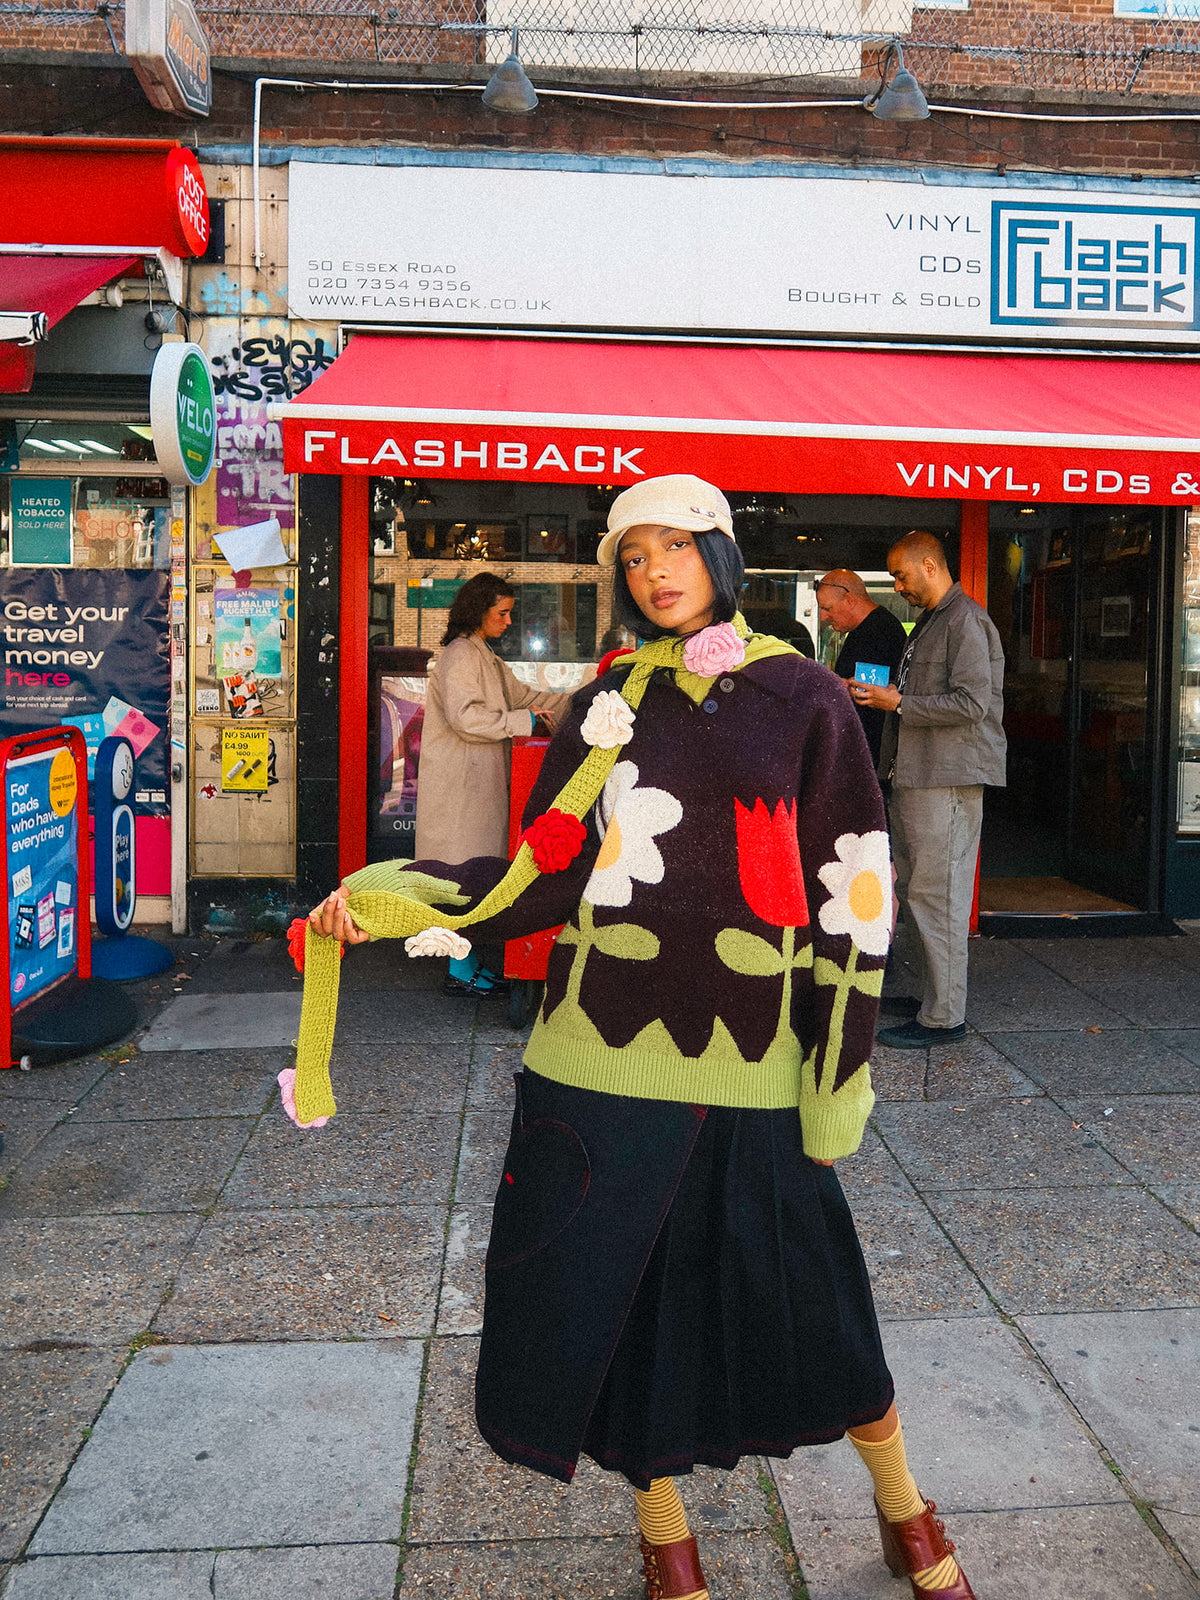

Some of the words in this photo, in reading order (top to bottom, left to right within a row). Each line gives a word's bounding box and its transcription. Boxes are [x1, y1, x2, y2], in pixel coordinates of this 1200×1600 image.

[168, 13, 207, 84] Mars
[184, 164, 204, 210] POST
[179, 186, 206, 242] OFFICE
[885, 212, 981, 233] VINYL
[308, 260, 332, 272] 50
[919, 255, 981, 274] CDs
[308, 277, 347, 289] 020
[357, 278, 410, 290] 7354
[418, 279, 471, 292] 9356
[1034, 251, 1186, 313] back
[309, 295, 552, 311] WWW.FLASHBACK.CO.UK
[892, 292, 907, 306] &
[896, 462, 1040, 496] VINYL,
[1063, 468, 1150, 494] CDs
[1170, 472, 1200, 495] &
[22, 498, 61, 507] HEATED
[17, 508, 65, 517] TOBACCO
[17, 521, 41, 529] SOLD
[42, 521, 66, 529] HERE
[4, 601, 58, 621] Get
[65, 605, 129, 625] your
[216, 600, 239, 608] FREE
[240, 600, 279, 608] MALIBU
[3, 624, 84, 643] travel
[5, 650, 104, 670] money
[5, 668, 71, 687] here
[224, 742, 249, 750] £4.99
[10, 783, 29, 799] For
[11, 796, 39, 816] Dads
[11, 818, 35, 835] who
[36, 811, 59, 827] have
[11, 824, 64, 853] everything
[116, 849, 129, 862] here
